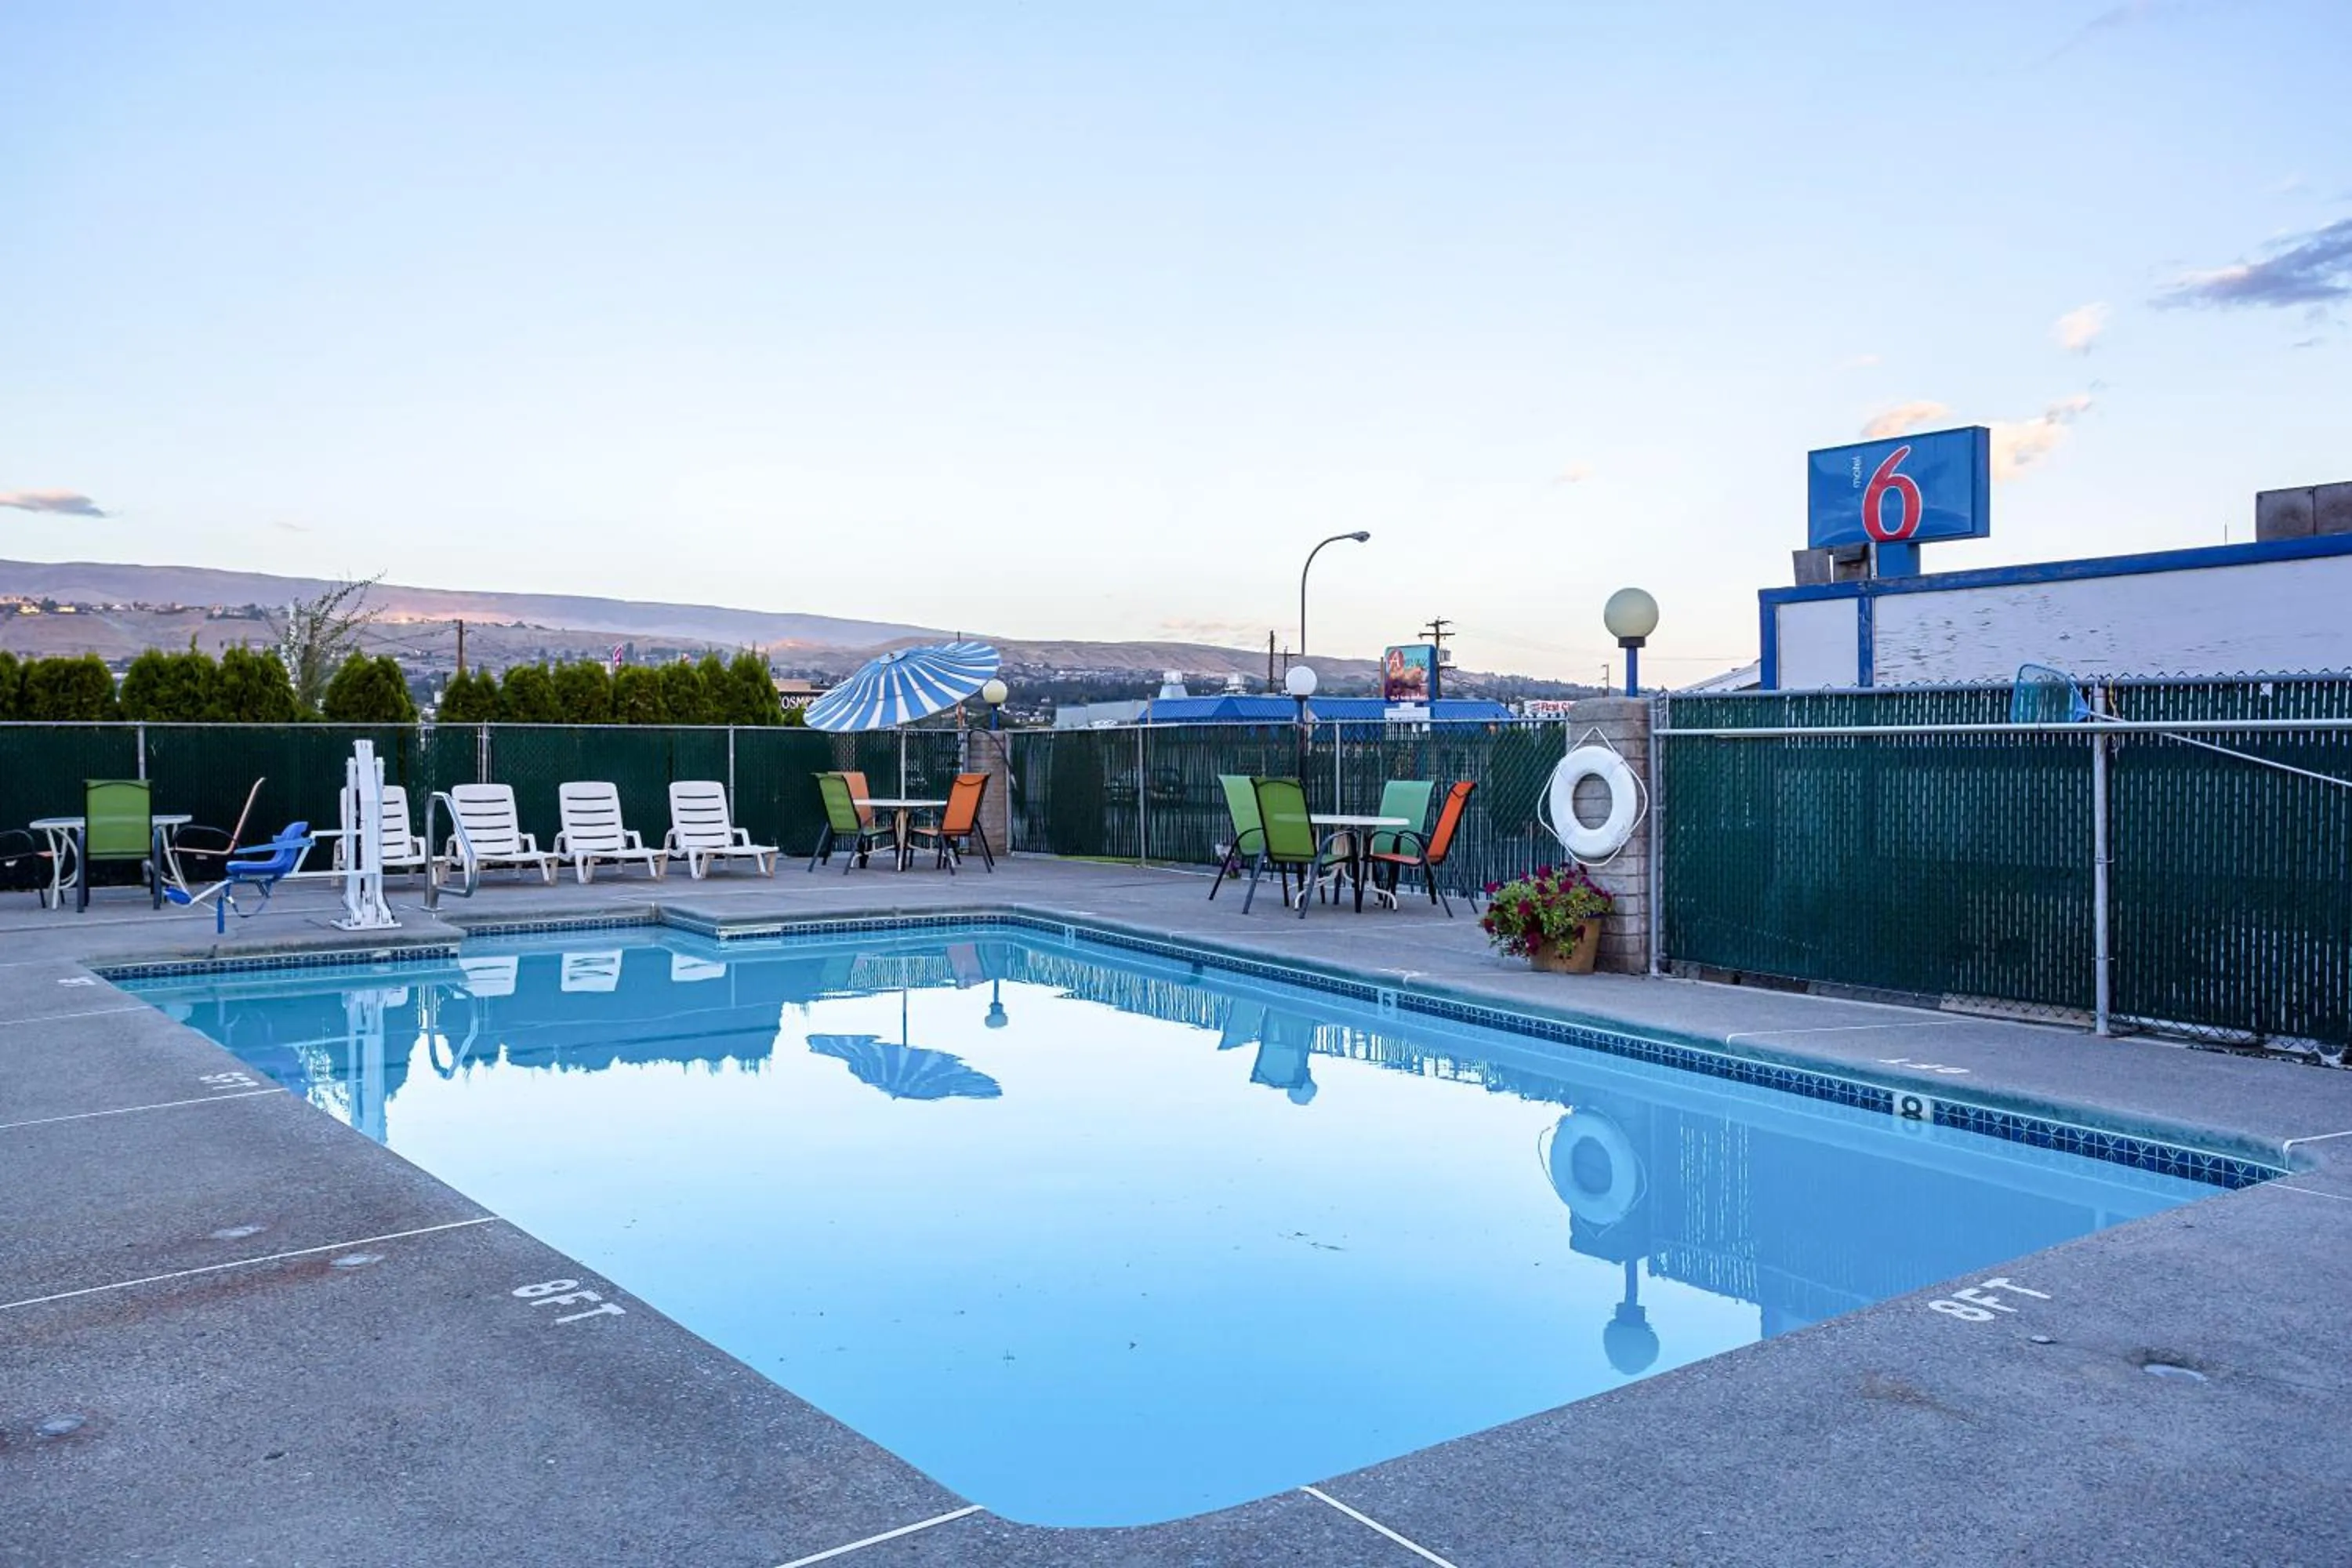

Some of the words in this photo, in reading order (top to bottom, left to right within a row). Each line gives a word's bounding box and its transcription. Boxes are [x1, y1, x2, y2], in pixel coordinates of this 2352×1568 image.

[1862, 445, 1922, 543] 6
[1382, 992, 1392, 1007] 5
[1901, 1095, 1923, 1121] 8
[512, 1279, 626, 1324] 8FT
[1929, 1278, 2052, 1321] 8FT
